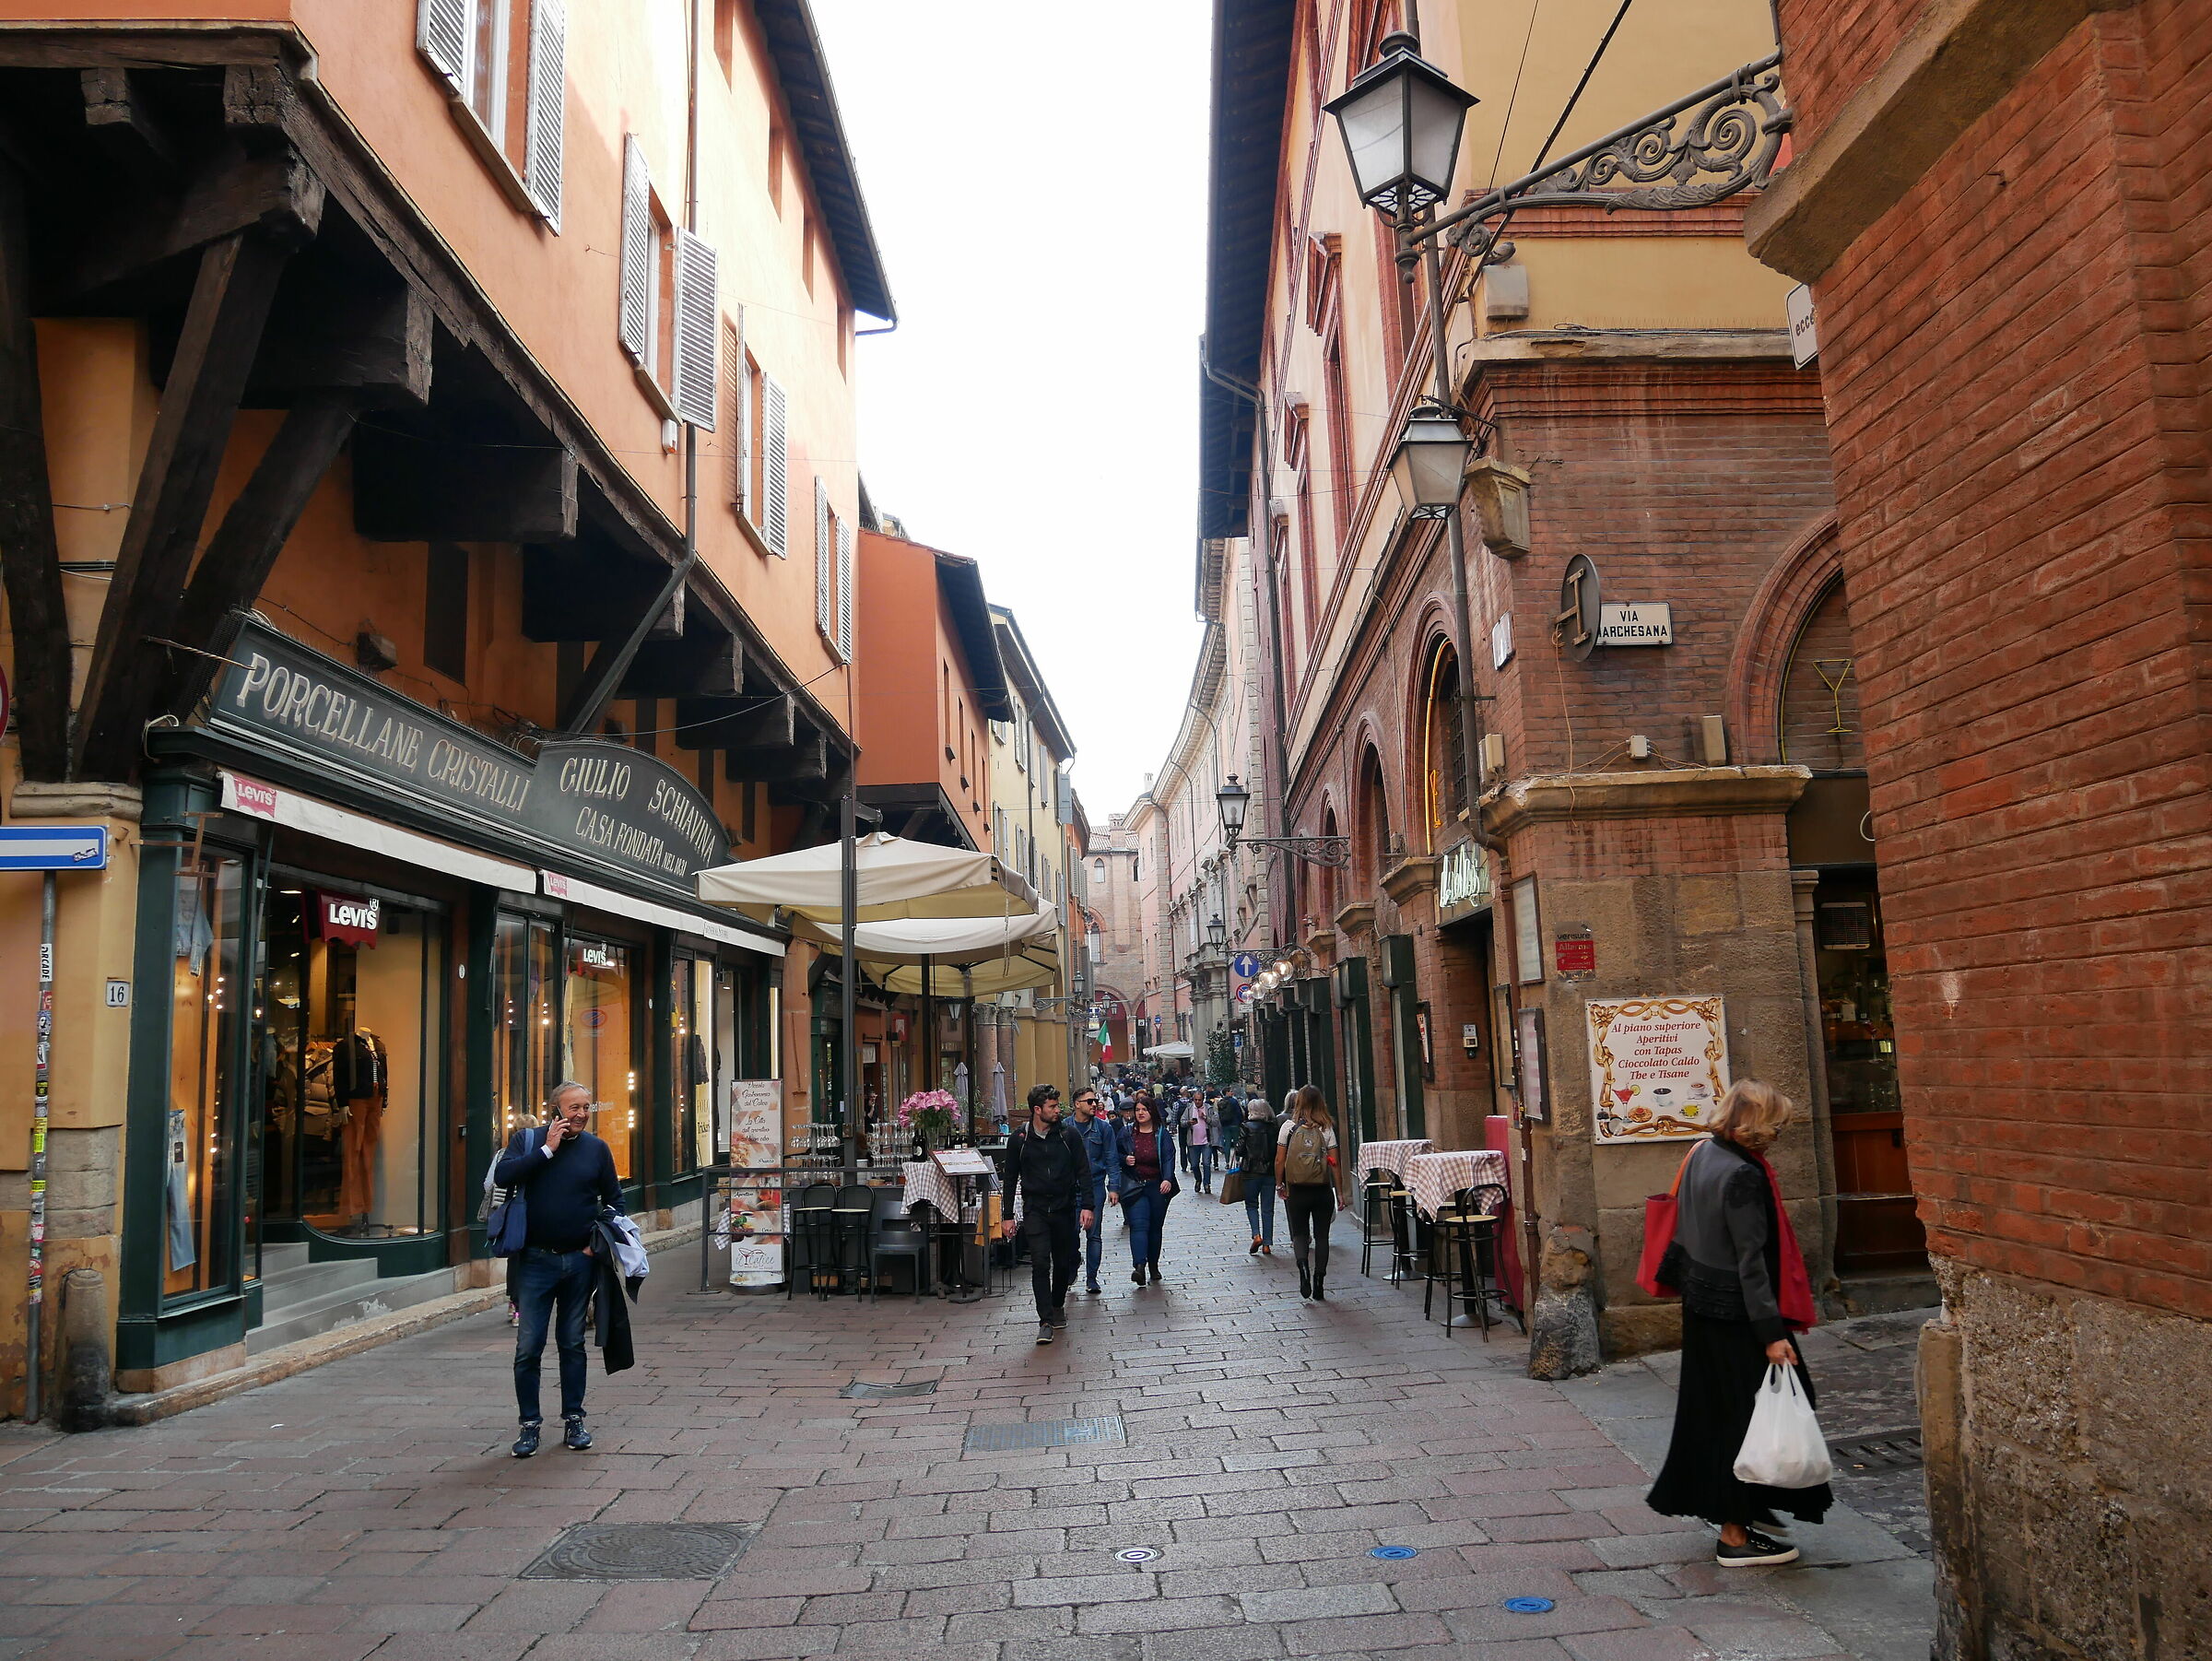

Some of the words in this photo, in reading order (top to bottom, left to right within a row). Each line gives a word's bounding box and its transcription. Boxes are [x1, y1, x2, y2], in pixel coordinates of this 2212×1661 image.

[1619, 610, 1639, 622] VIA
[236, 653, 424, 771] PORCELLANE
[427, 738, 532, 812] CRISTALLI
[559, 757, 631, 798] GIULIO
[647, 779, 716, 864] SCHIAVINA
[575, 806, 616, 847] CASA
[614, 822, 665, 866] FONDATA
[662, 852, 676, 872] NEL
[110, 985, 124, 1003] 16
[1611, 1023, 1622, 1033] Al
[1623, 1024, 1652, 1034] piano
[1654, 1021, 1701, 1032] superiore
[1636, 1033, 1678, 1045] Aperitivi
[1654, 1046, 1683, 1057] Tapas
[1618, 1058, 1668, 1069] Cioccolato
[1671, 1057, 1700, 1066] Caldo
[1630, 1070, 1648, 1080] The
[1659, 1070, 1690, 1079] Tisane
